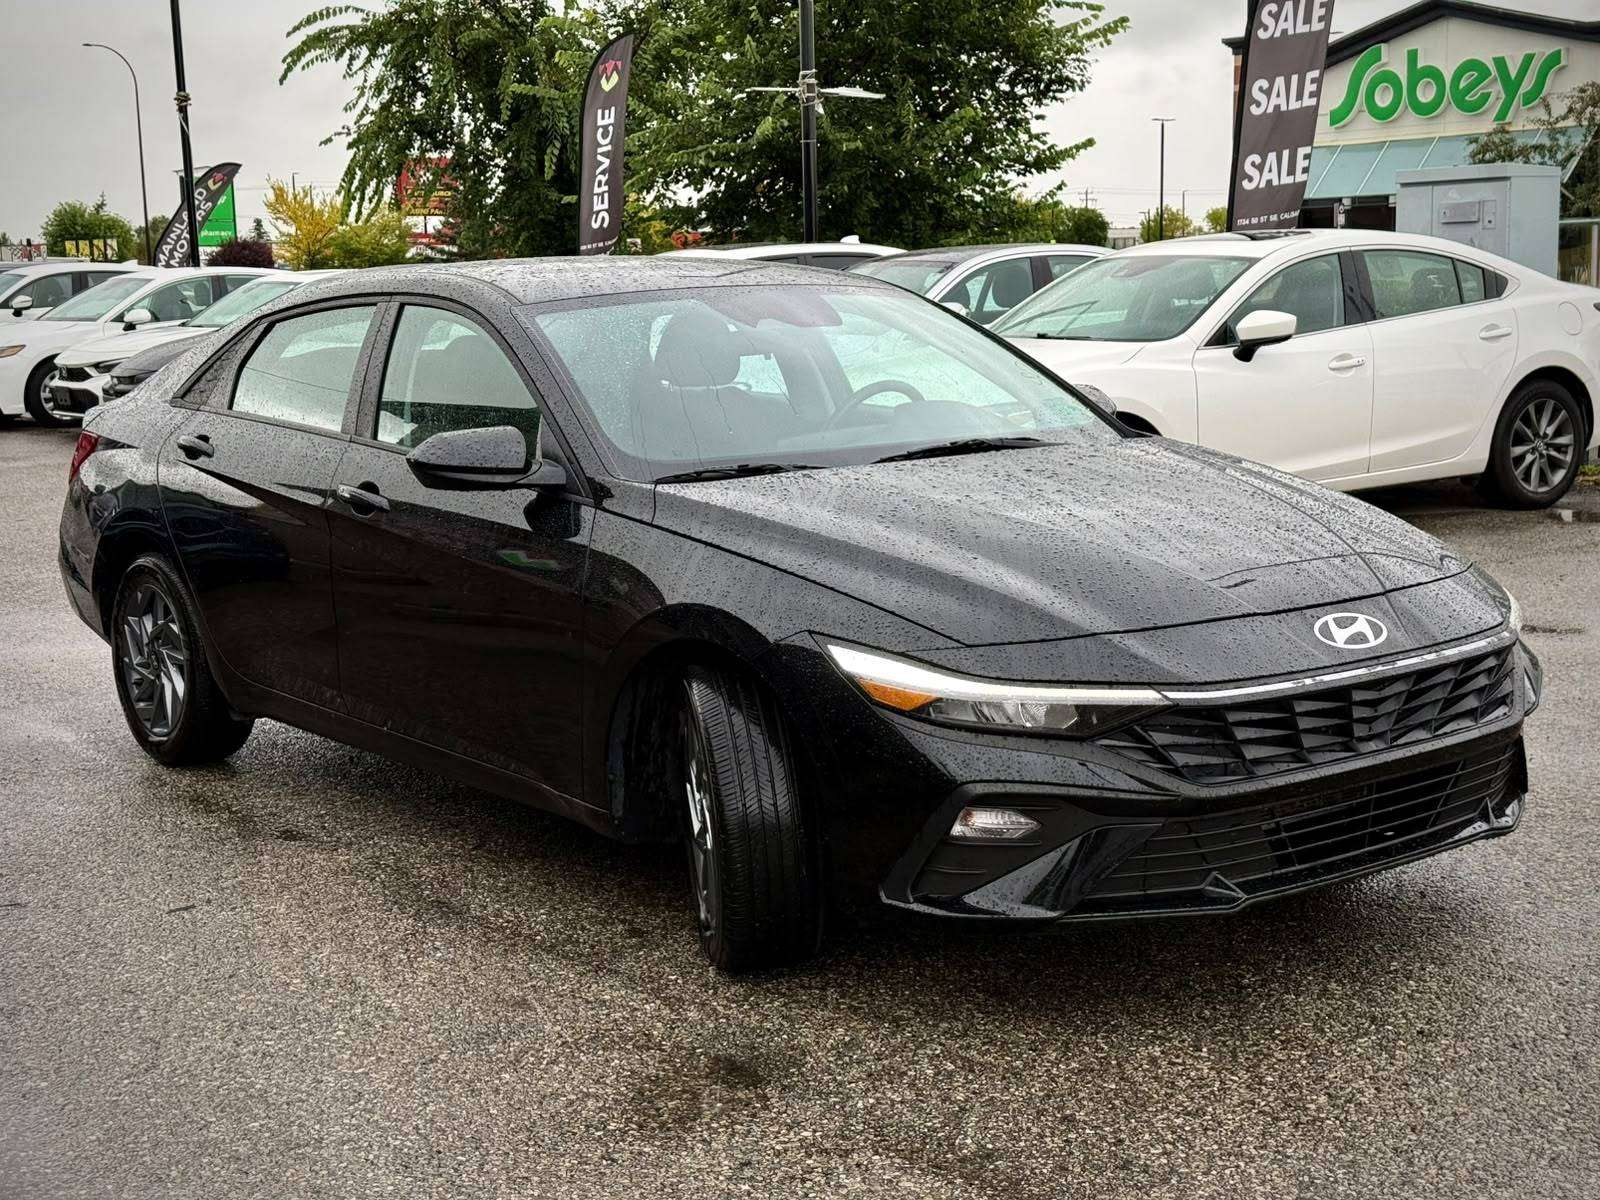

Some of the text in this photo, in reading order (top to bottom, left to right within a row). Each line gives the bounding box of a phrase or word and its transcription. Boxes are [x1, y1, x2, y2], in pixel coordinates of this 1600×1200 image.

[1257, 0, 1328, 40] SALE
[1249, 69, 1320, 116] SALE
[1329, 43, 1566, 128] Sobeys
[591, 106, 615, 229] SERVICE
[1241, 146, 1311, 190] SALE
